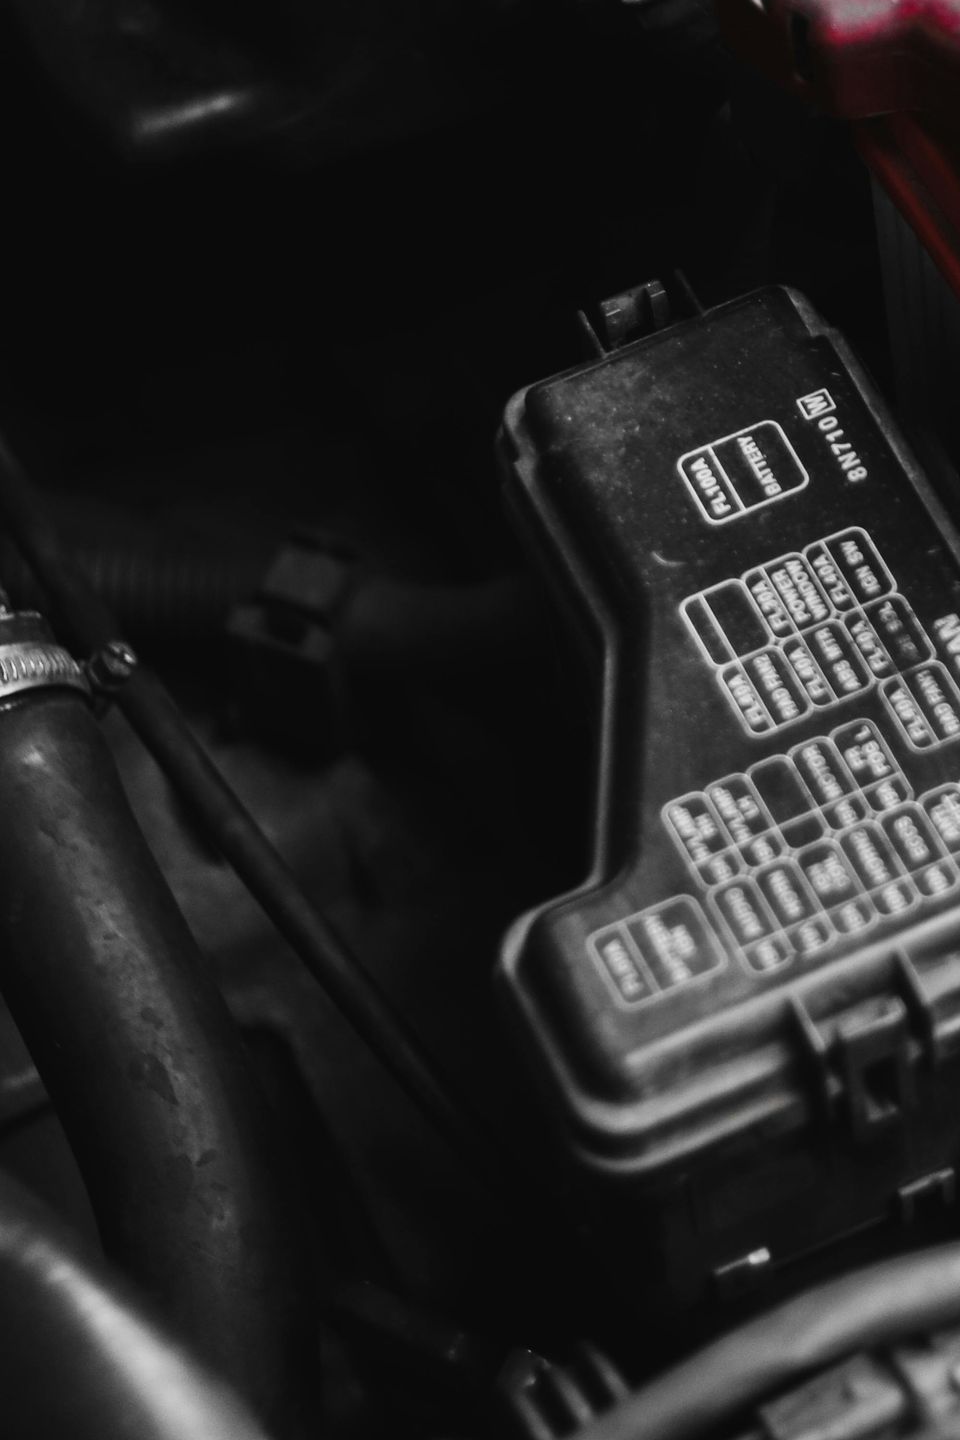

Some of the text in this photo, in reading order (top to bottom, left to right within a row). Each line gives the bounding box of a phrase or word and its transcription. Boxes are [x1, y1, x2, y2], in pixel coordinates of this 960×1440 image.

[737, 436, 781, 495] BATTERY
[818, 416, 866, 481] 8N710
[691, 458, 730, 514] FL100A
[842, 541, 863, 564] SW
[772, 570, 810, 621] POWER
[785, 560, 826, 618] WINDOW
[772, 688, 797, 717] RAD
[934, 703, 960, 733] RAD
[803, 745, 842, 798] MOTOR
